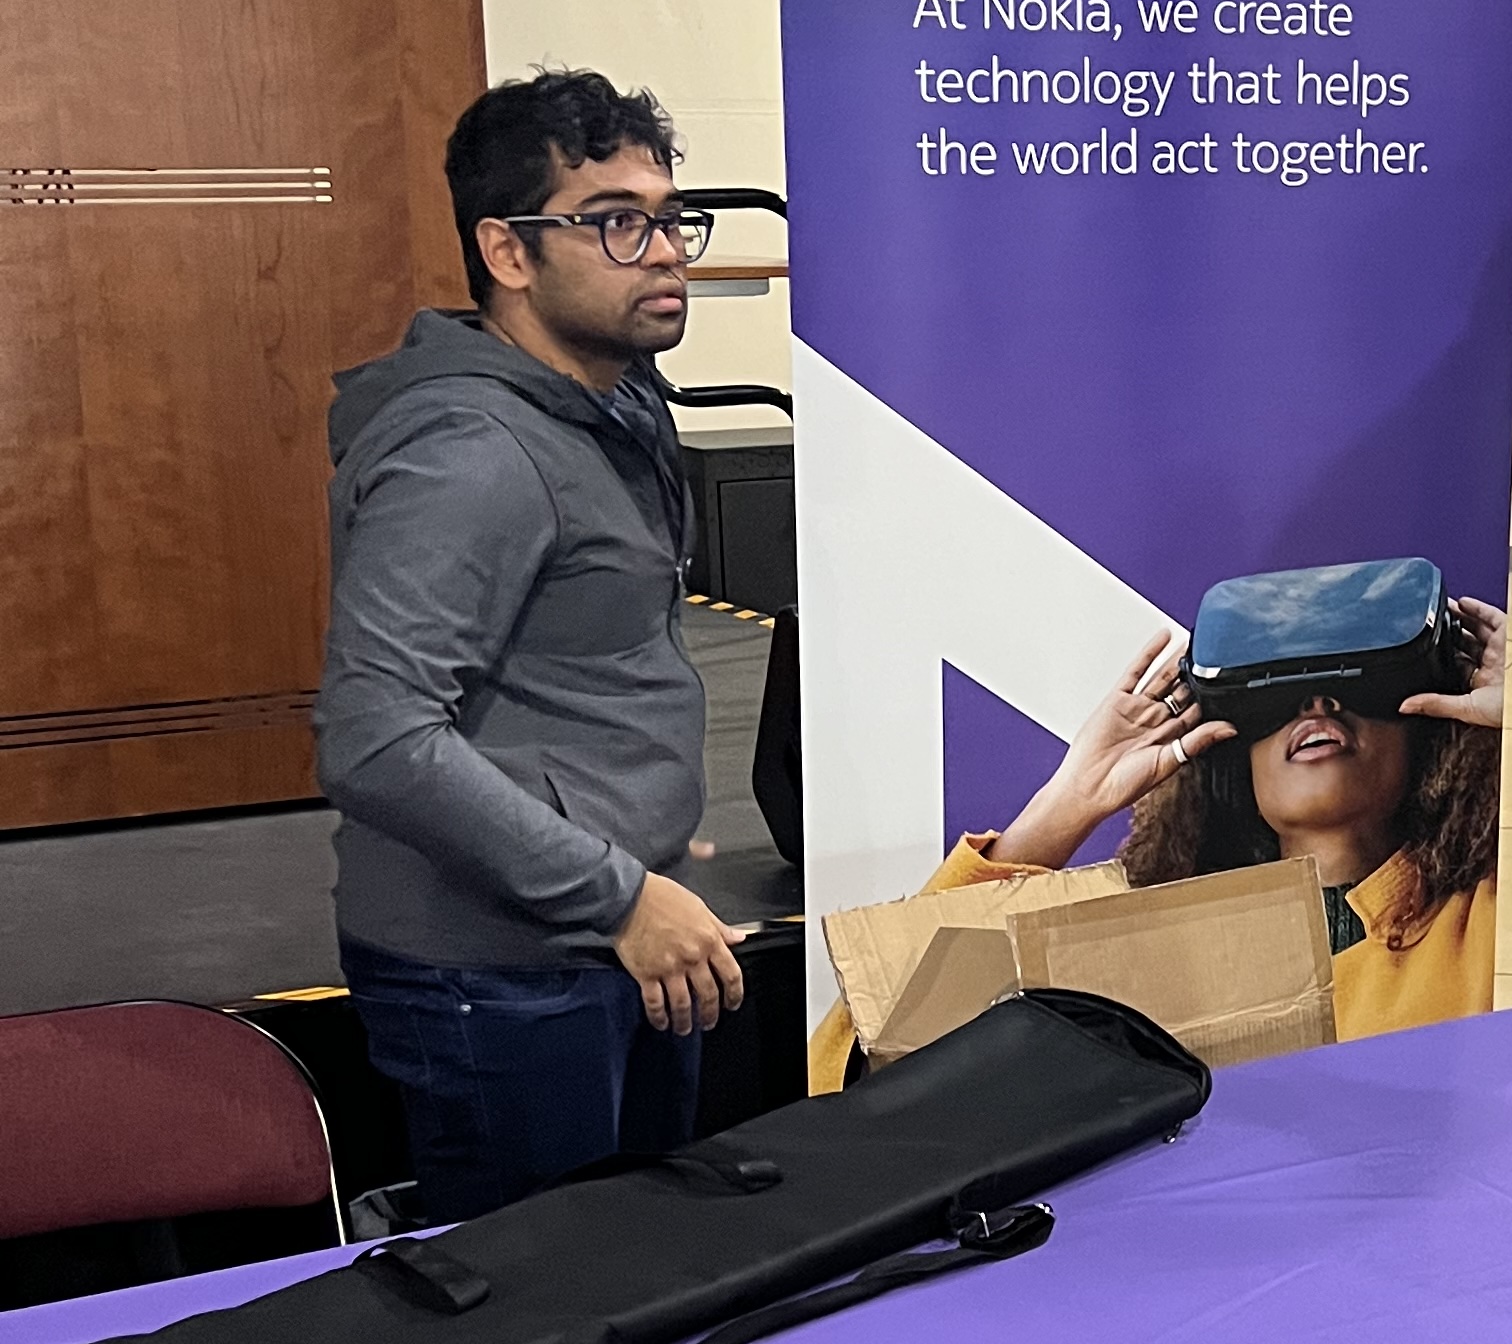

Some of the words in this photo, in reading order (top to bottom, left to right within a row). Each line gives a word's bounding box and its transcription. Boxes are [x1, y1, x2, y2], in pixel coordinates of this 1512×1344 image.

[1137, 0, 1199, 34] we
[914, 54, 1175, 117] technology
[1187, 57, 1282, 105] that
[1297, 58, 1410, 118] helps
[916, 127, 997, 176] the
[1011, 127, 1137, 175] world
[1152, 132, 1219, 174] act
[1231, 128, 1429, 187] together.
